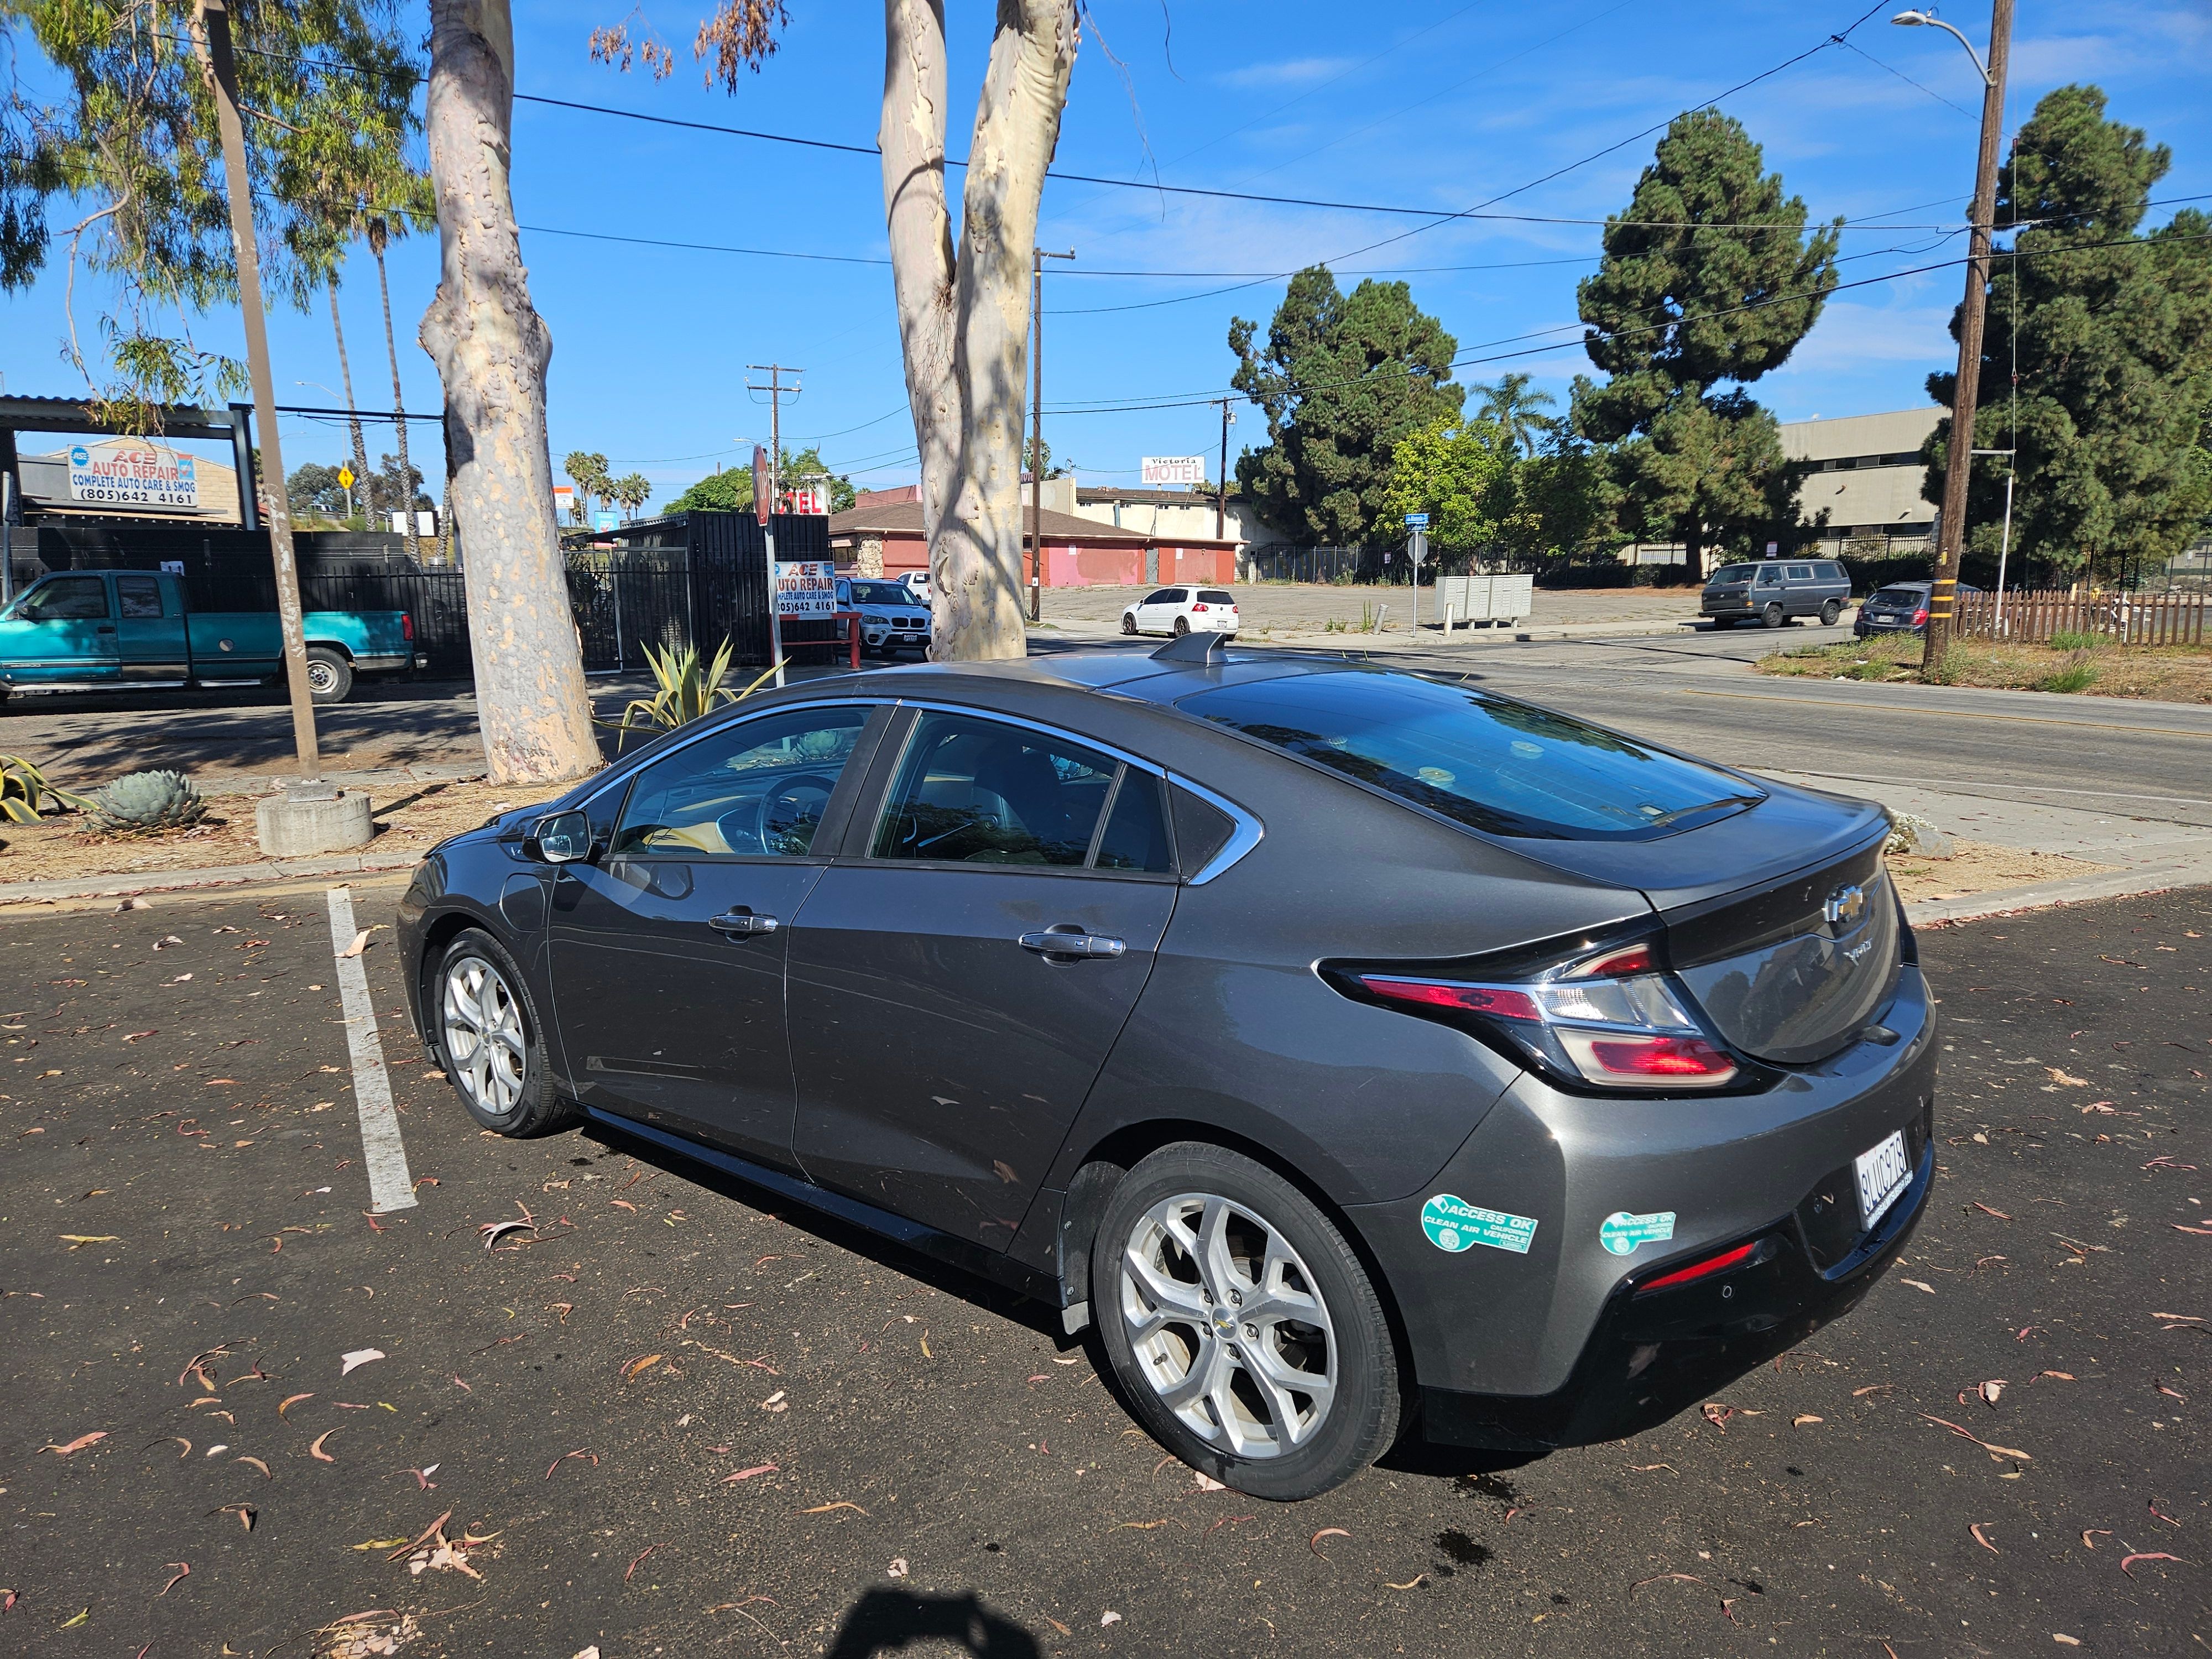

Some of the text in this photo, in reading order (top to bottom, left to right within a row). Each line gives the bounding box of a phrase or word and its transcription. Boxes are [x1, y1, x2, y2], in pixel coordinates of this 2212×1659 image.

[73, 452, 87, 460] ASE
[112, 450, 156, 466] ACE
[92, 461, 179, 481] AUTO REPAIR
[1145, 465, 1203, 481] MOTEL
[73, 474, 195, 493] COMPLETE AUTO CARE & SMOG
[753, 470, 768, 501] STOP
[81, 488, 191, 504] (805)642 4161
[788, 563, 817, 576] ACE
[776, 577, 833, 591] UTO REPAIR
[778, 592, 793, 600] MPLETE
[794, 592, 805, 600] AUTO
[806, 591, 817, 599] CARE
[822, 591, 833, 599] SMOG
[778, 601, 834, 613] 05)642 4161
[1861, 1136, 1905, 1212] 8LUC978
[1448, 1205, 1534, 1230] ACCESS OK
[1619, 1216, 1658, 1227] ACCESS
[1424, 1216, 1528, 1244] CLEAN AIR VEHICLE
[1490, 1224, 1530, 1238] CALIFORNIA
